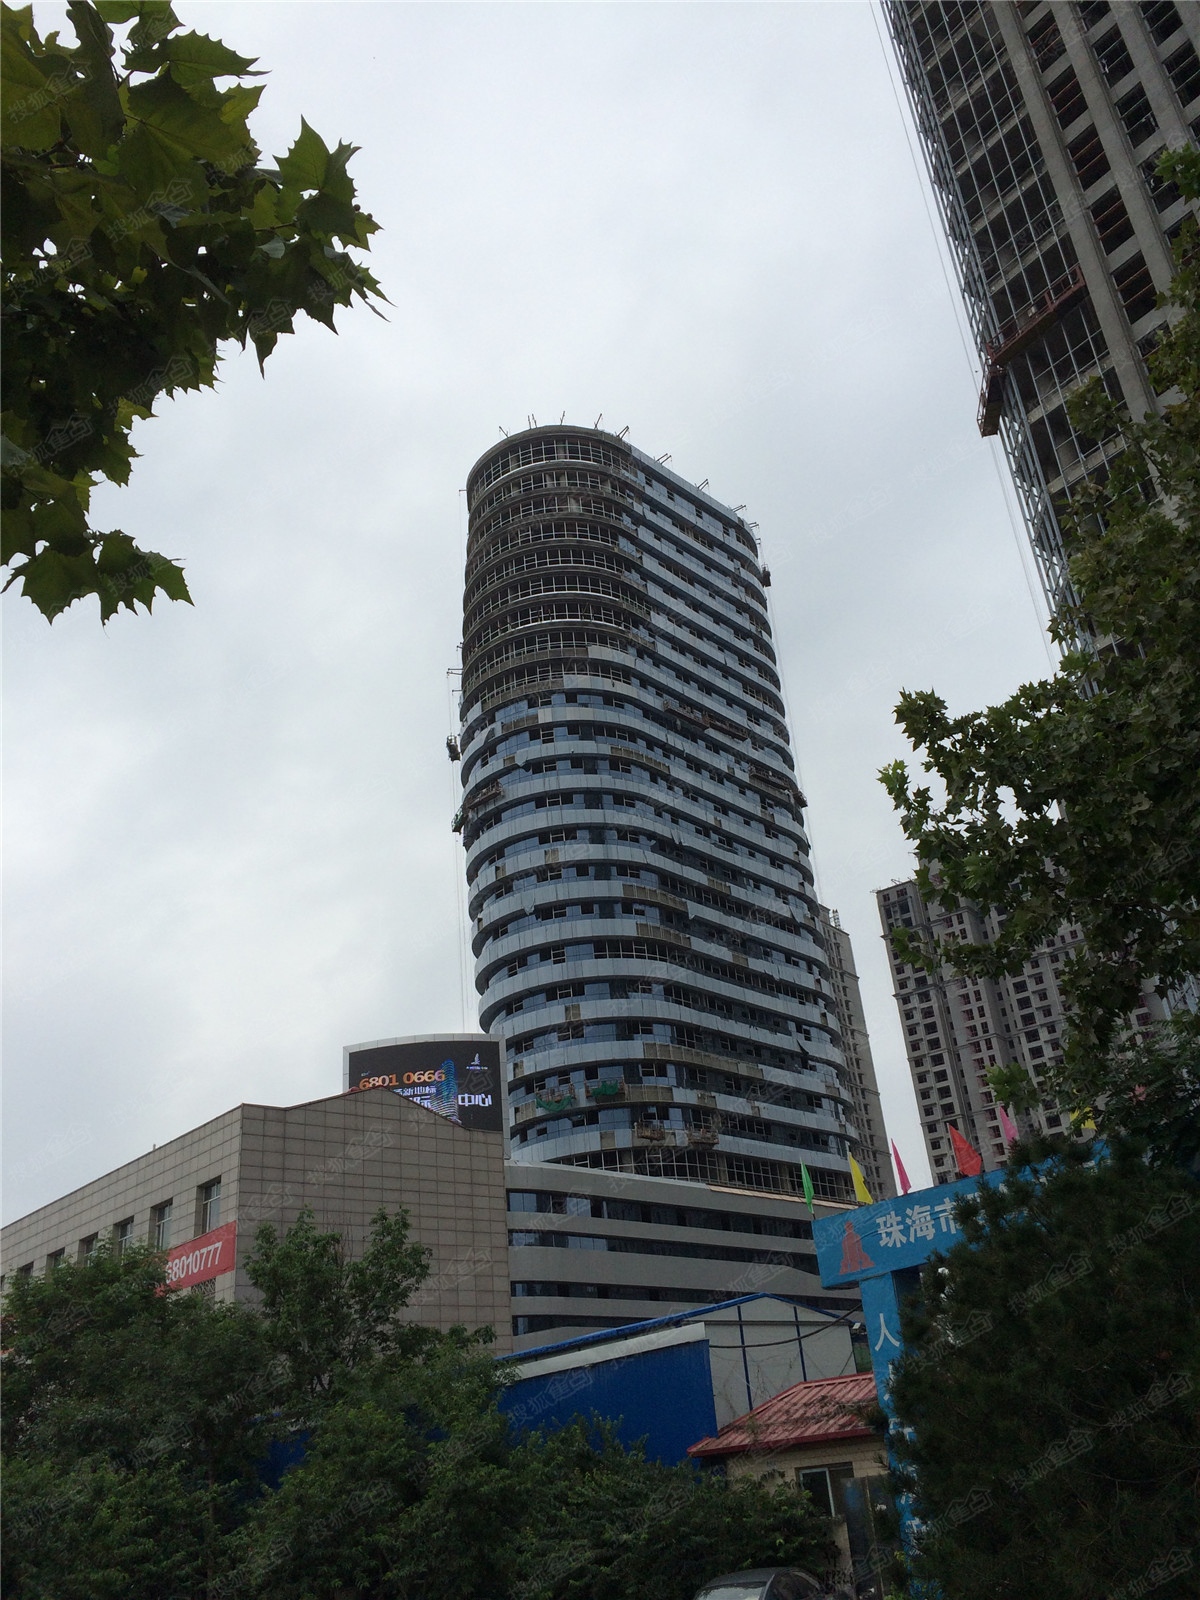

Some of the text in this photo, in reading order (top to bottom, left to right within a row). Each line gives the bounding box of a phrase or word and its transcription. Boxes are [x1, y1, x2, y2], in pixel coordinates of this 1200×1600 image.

[359, 1069, 446, 1091] 6801 0666
[457, 1093, 493, 1107] 中心
[165, 1241, 223, 1285] 68010777
